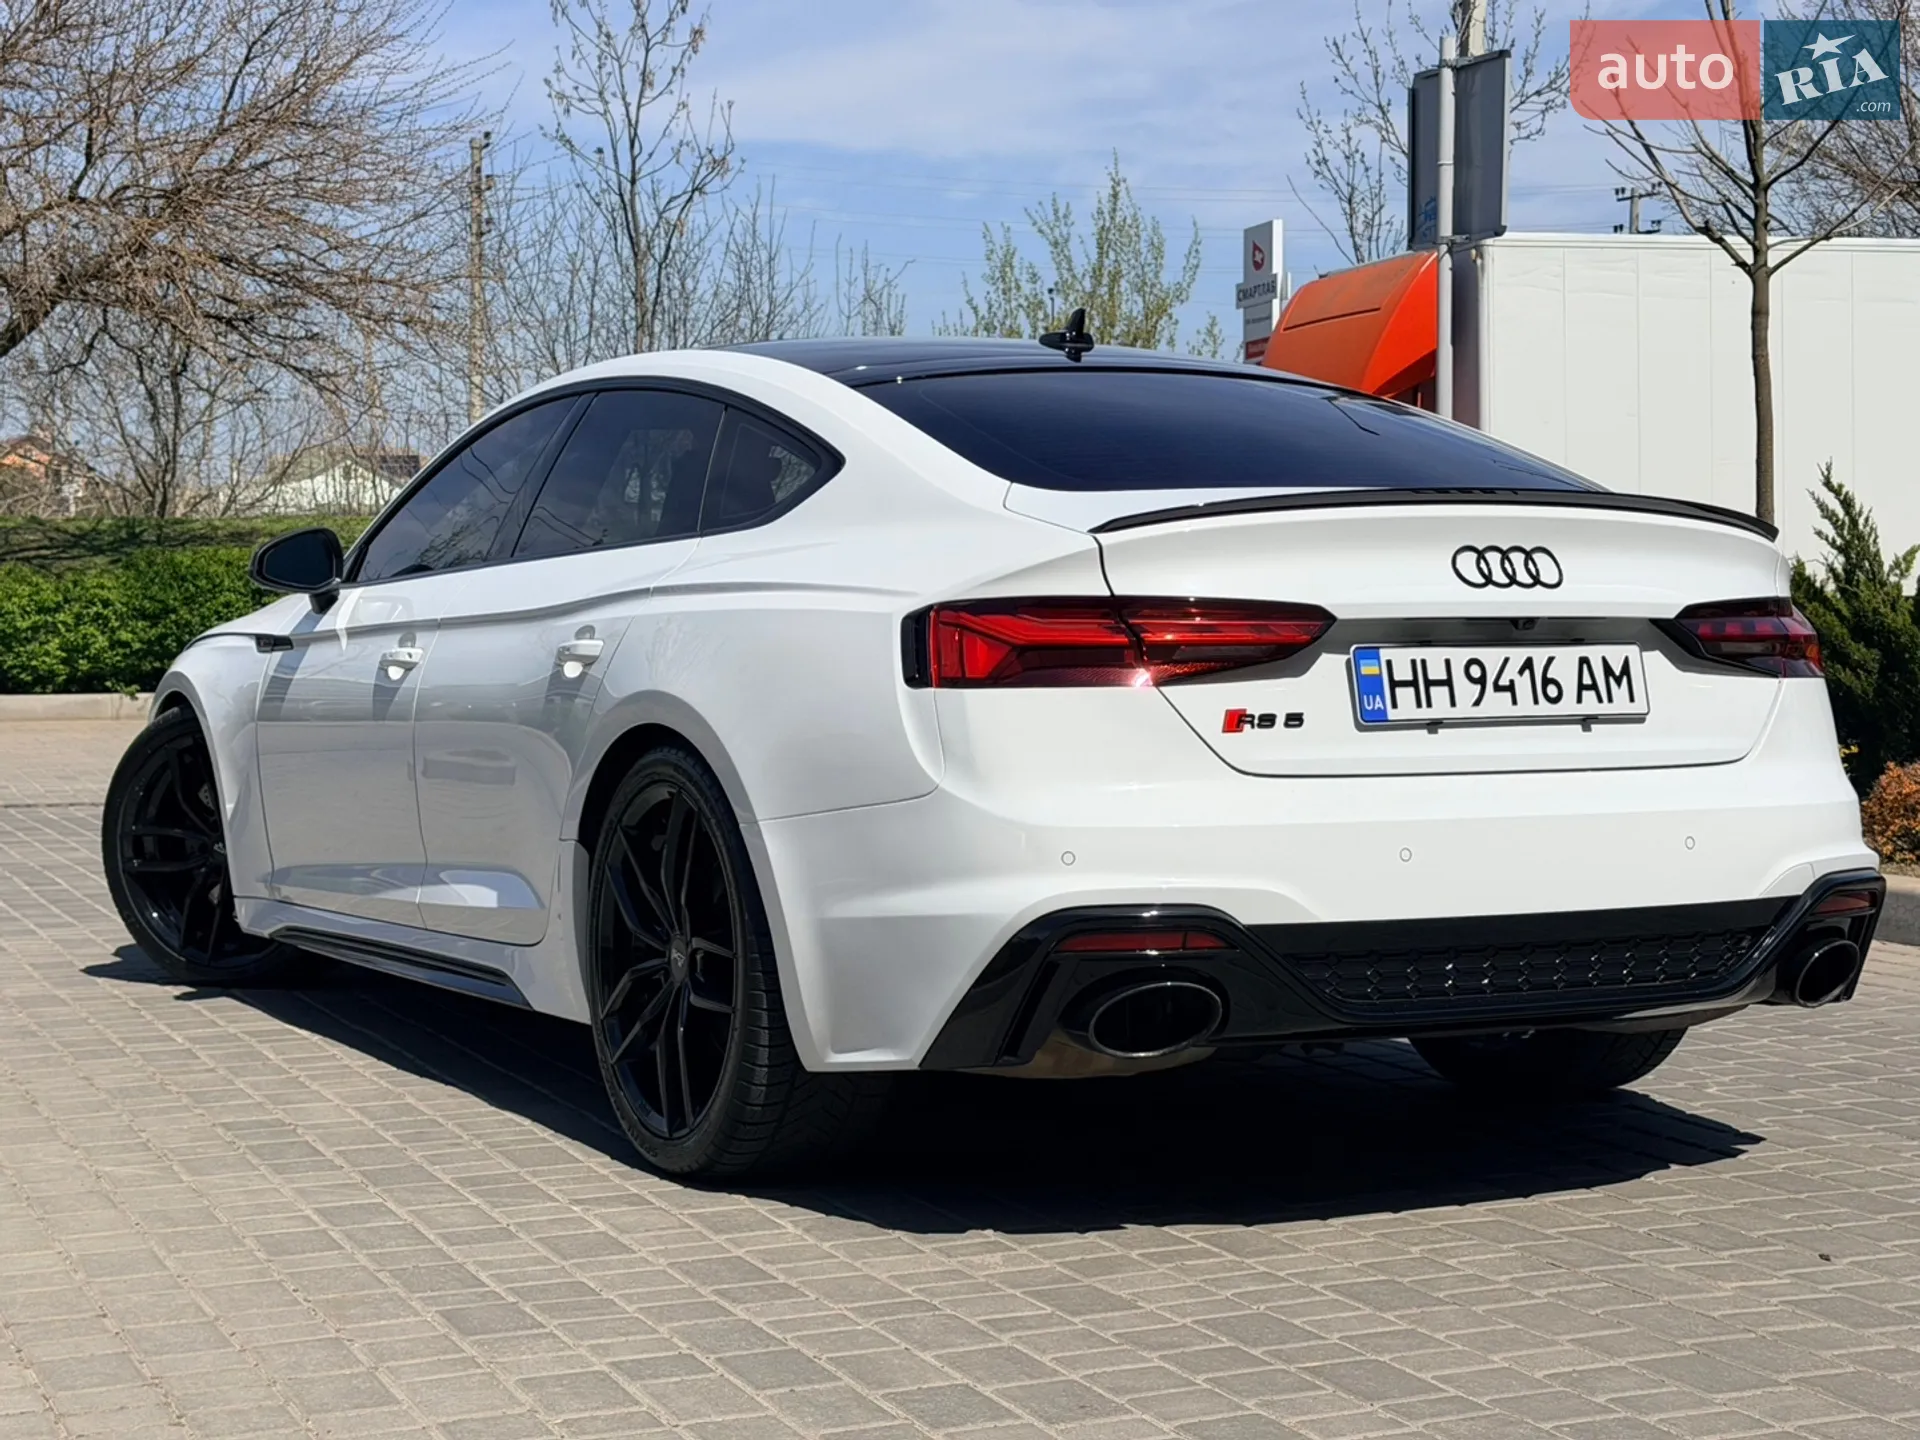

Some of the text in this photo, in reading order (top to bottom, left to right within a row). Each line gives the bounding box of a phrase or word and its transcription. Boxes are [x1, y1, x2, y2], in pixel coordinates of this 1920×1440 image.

[1386, 654, 1636, 710] HH 9416 AM
[1362, 694, 1385, 711] UA
[1231, 711, 1305, 730] RS 5
